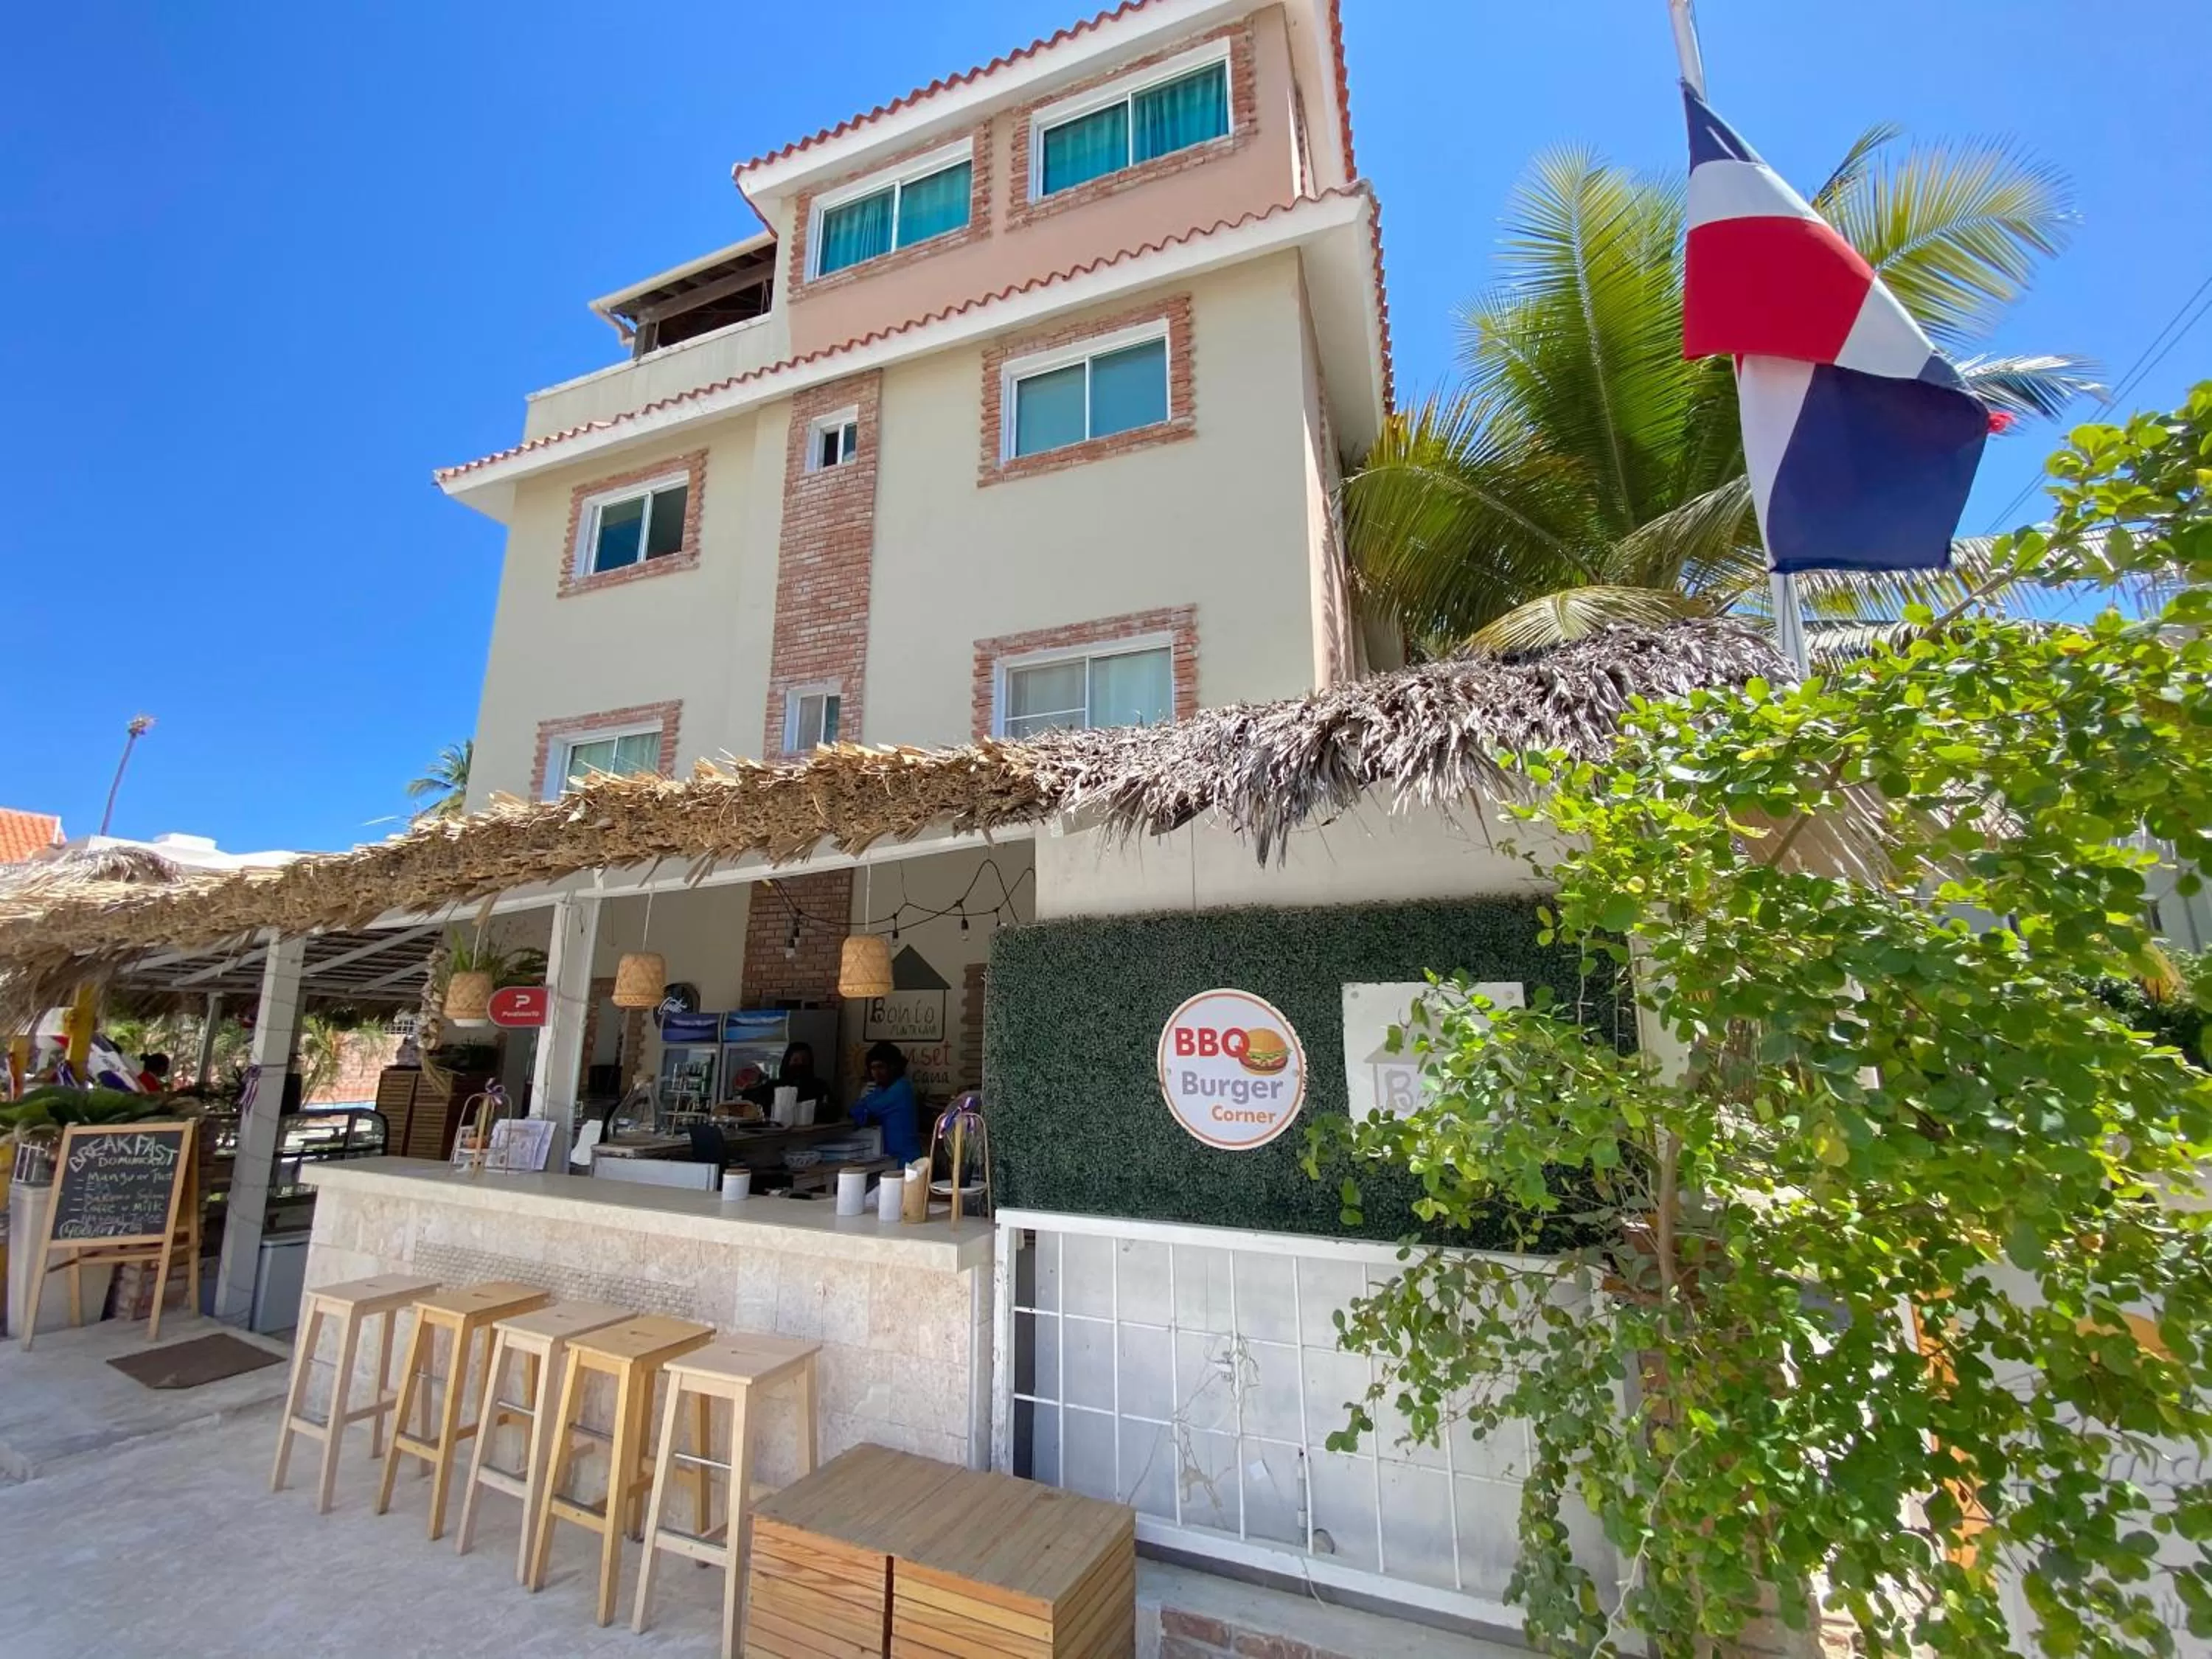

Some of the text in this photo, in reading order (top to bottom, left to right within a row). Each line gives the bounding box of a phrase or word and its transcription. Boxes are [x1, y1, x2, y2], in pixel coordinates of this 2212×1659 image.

[1175, 1027, 1251, 1060] BBQ
[1181, 1071, 1284, 1105] Burger
[1211, 1105, 1276, 1124] Corner
[69, 1134, 178, 1173] BREAKFAST
